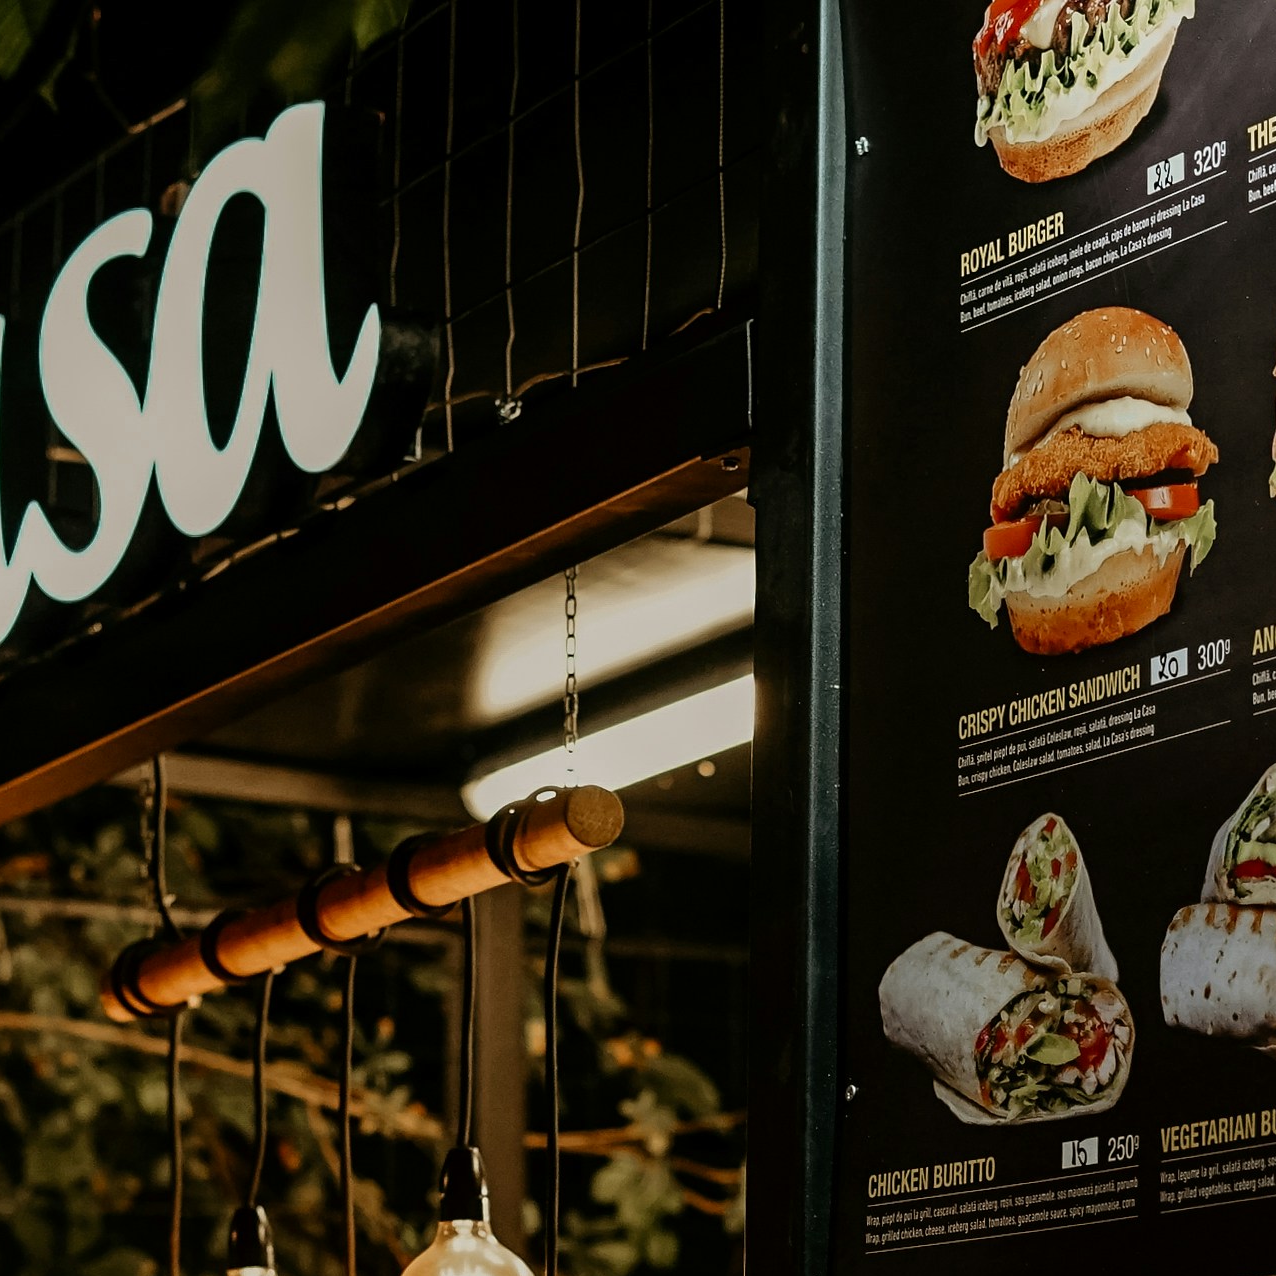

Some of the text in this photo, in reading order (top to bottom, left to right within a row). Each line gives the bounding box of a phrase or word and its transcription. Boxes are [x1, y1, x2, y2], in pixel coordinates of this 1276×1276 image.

[960, 211, 1063, 277] ROYAL BURGER
[958, 663, 1140, 739] CRISPY CHICKEN SANDWICH
[1160, 1112, 1255, 1152] VEGETARIAN
[868, 1156, 995, 1198] CHICKEN BURITTO
